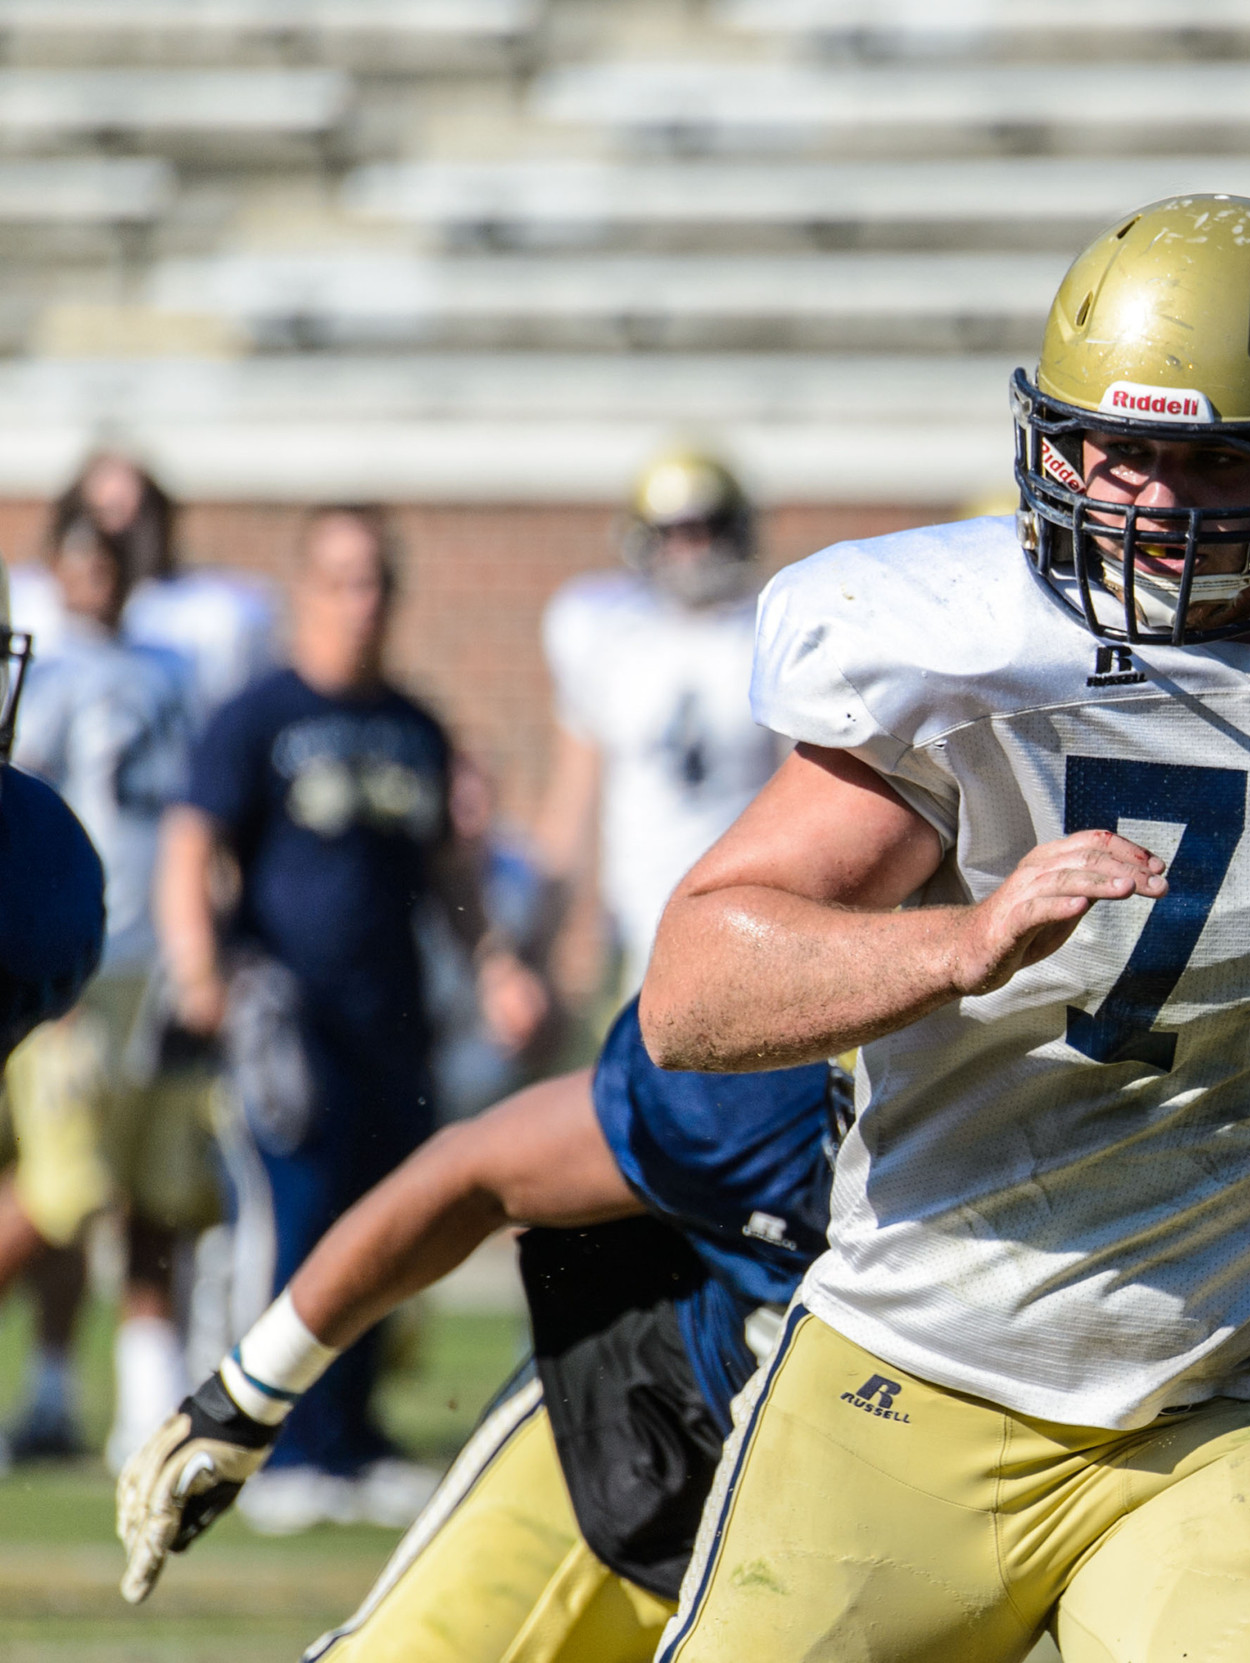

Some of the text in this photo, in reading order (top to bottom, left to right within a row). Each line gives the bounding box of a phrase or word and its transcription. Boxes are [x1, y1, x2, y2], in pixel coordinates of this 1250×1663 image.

[1112, 389, 1199, 416] Riddell
[1095, 645, 1133, 674] R
[855, 1373, 902, 1410] R
[840, 1391, 911, 1424] RUSSELL
